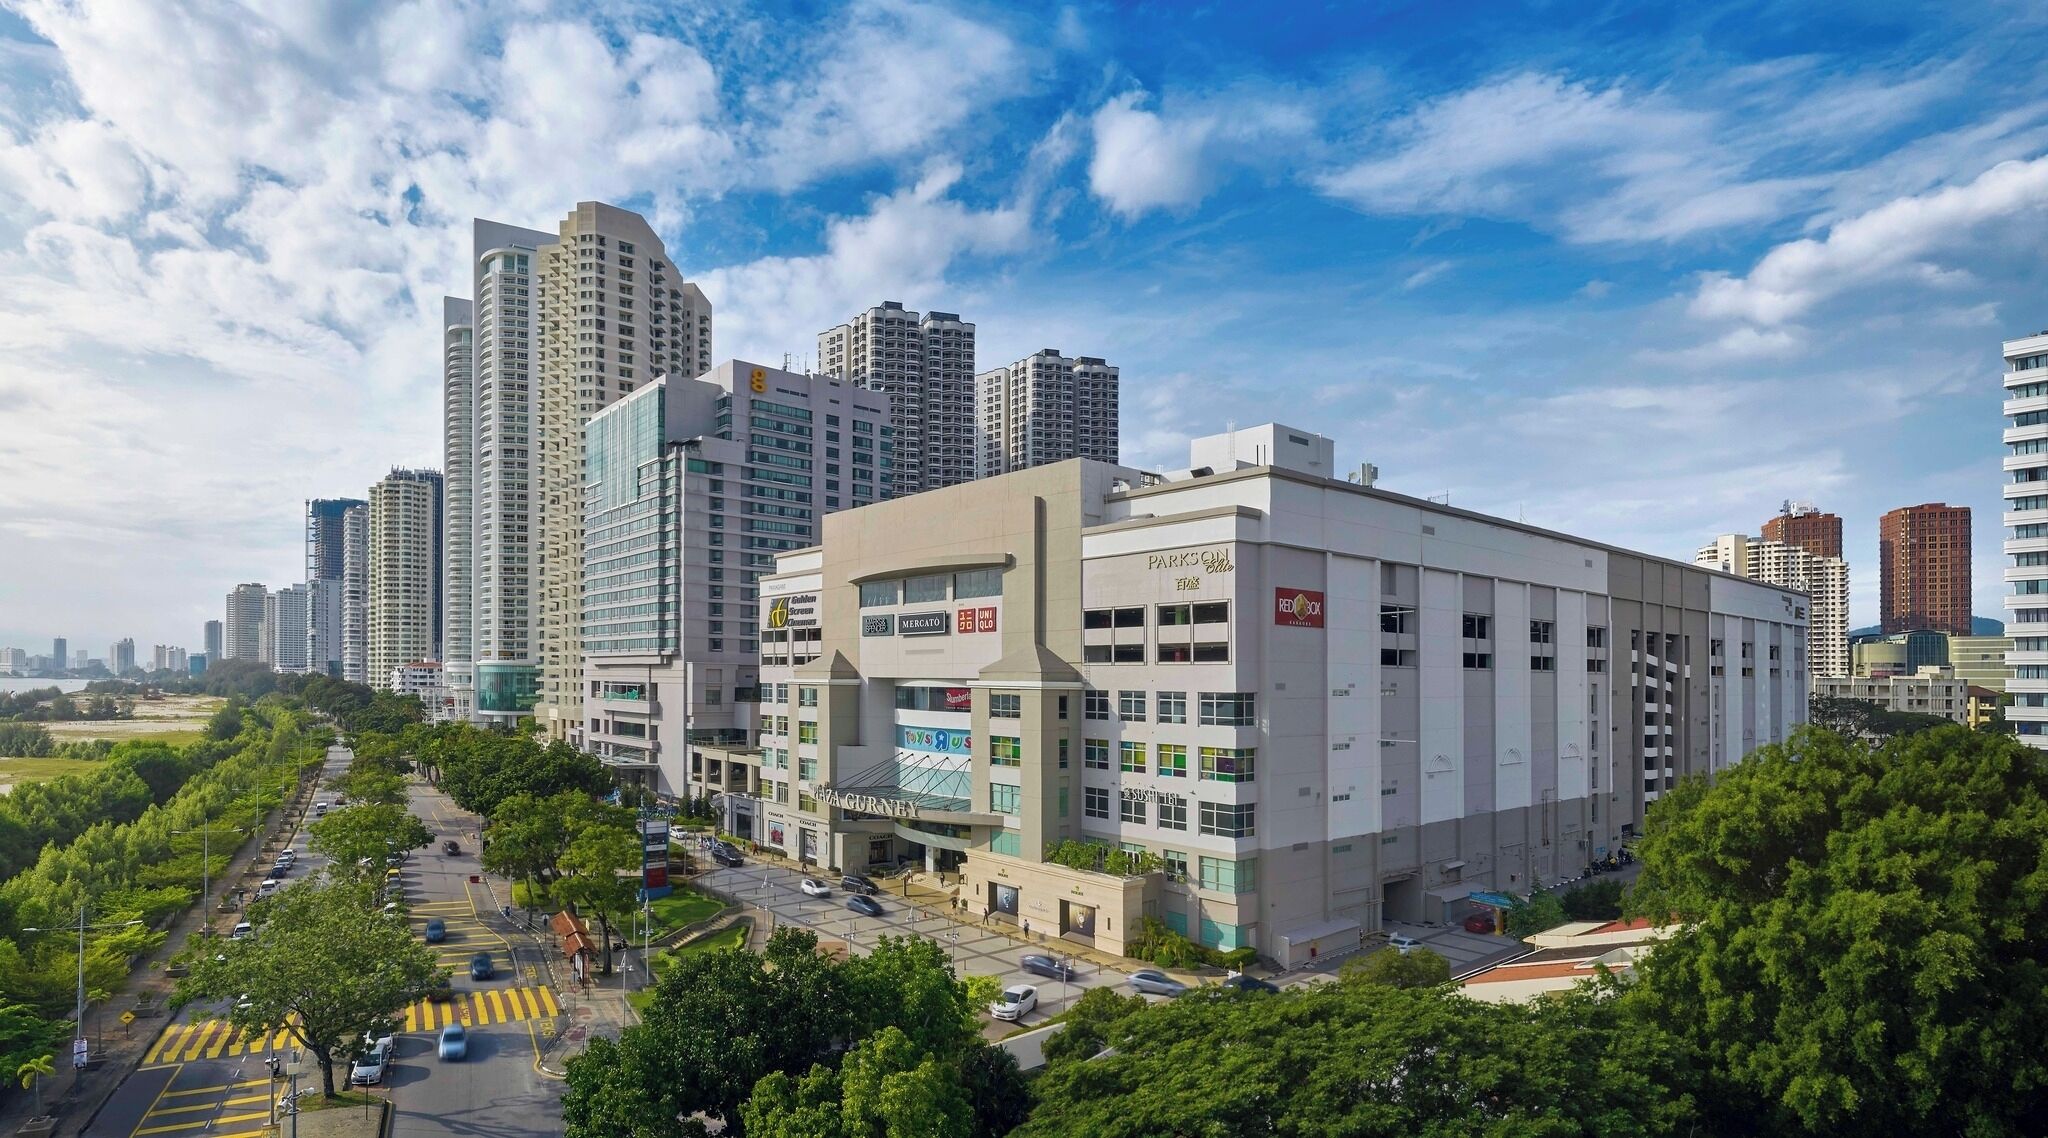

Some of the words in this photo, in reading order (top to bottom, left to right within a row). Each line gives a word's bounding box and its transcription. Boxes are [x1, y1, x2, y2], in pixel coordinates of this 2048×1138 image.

[1148, 548, 1229, 570] PARKSON
[1175, 576, 1200, 591] 百盛
[791, 594, 816, 604] Golden
[1279, 598, 1294, 613] RED
[789, 607, 814, 616] Screen
[979, 610, 992, 619] UNI
[979, 620, 993, 630] QLO
[1132, 788, 1158, 803] SUSHI
[845, 792, 919, 818] GURNEY
